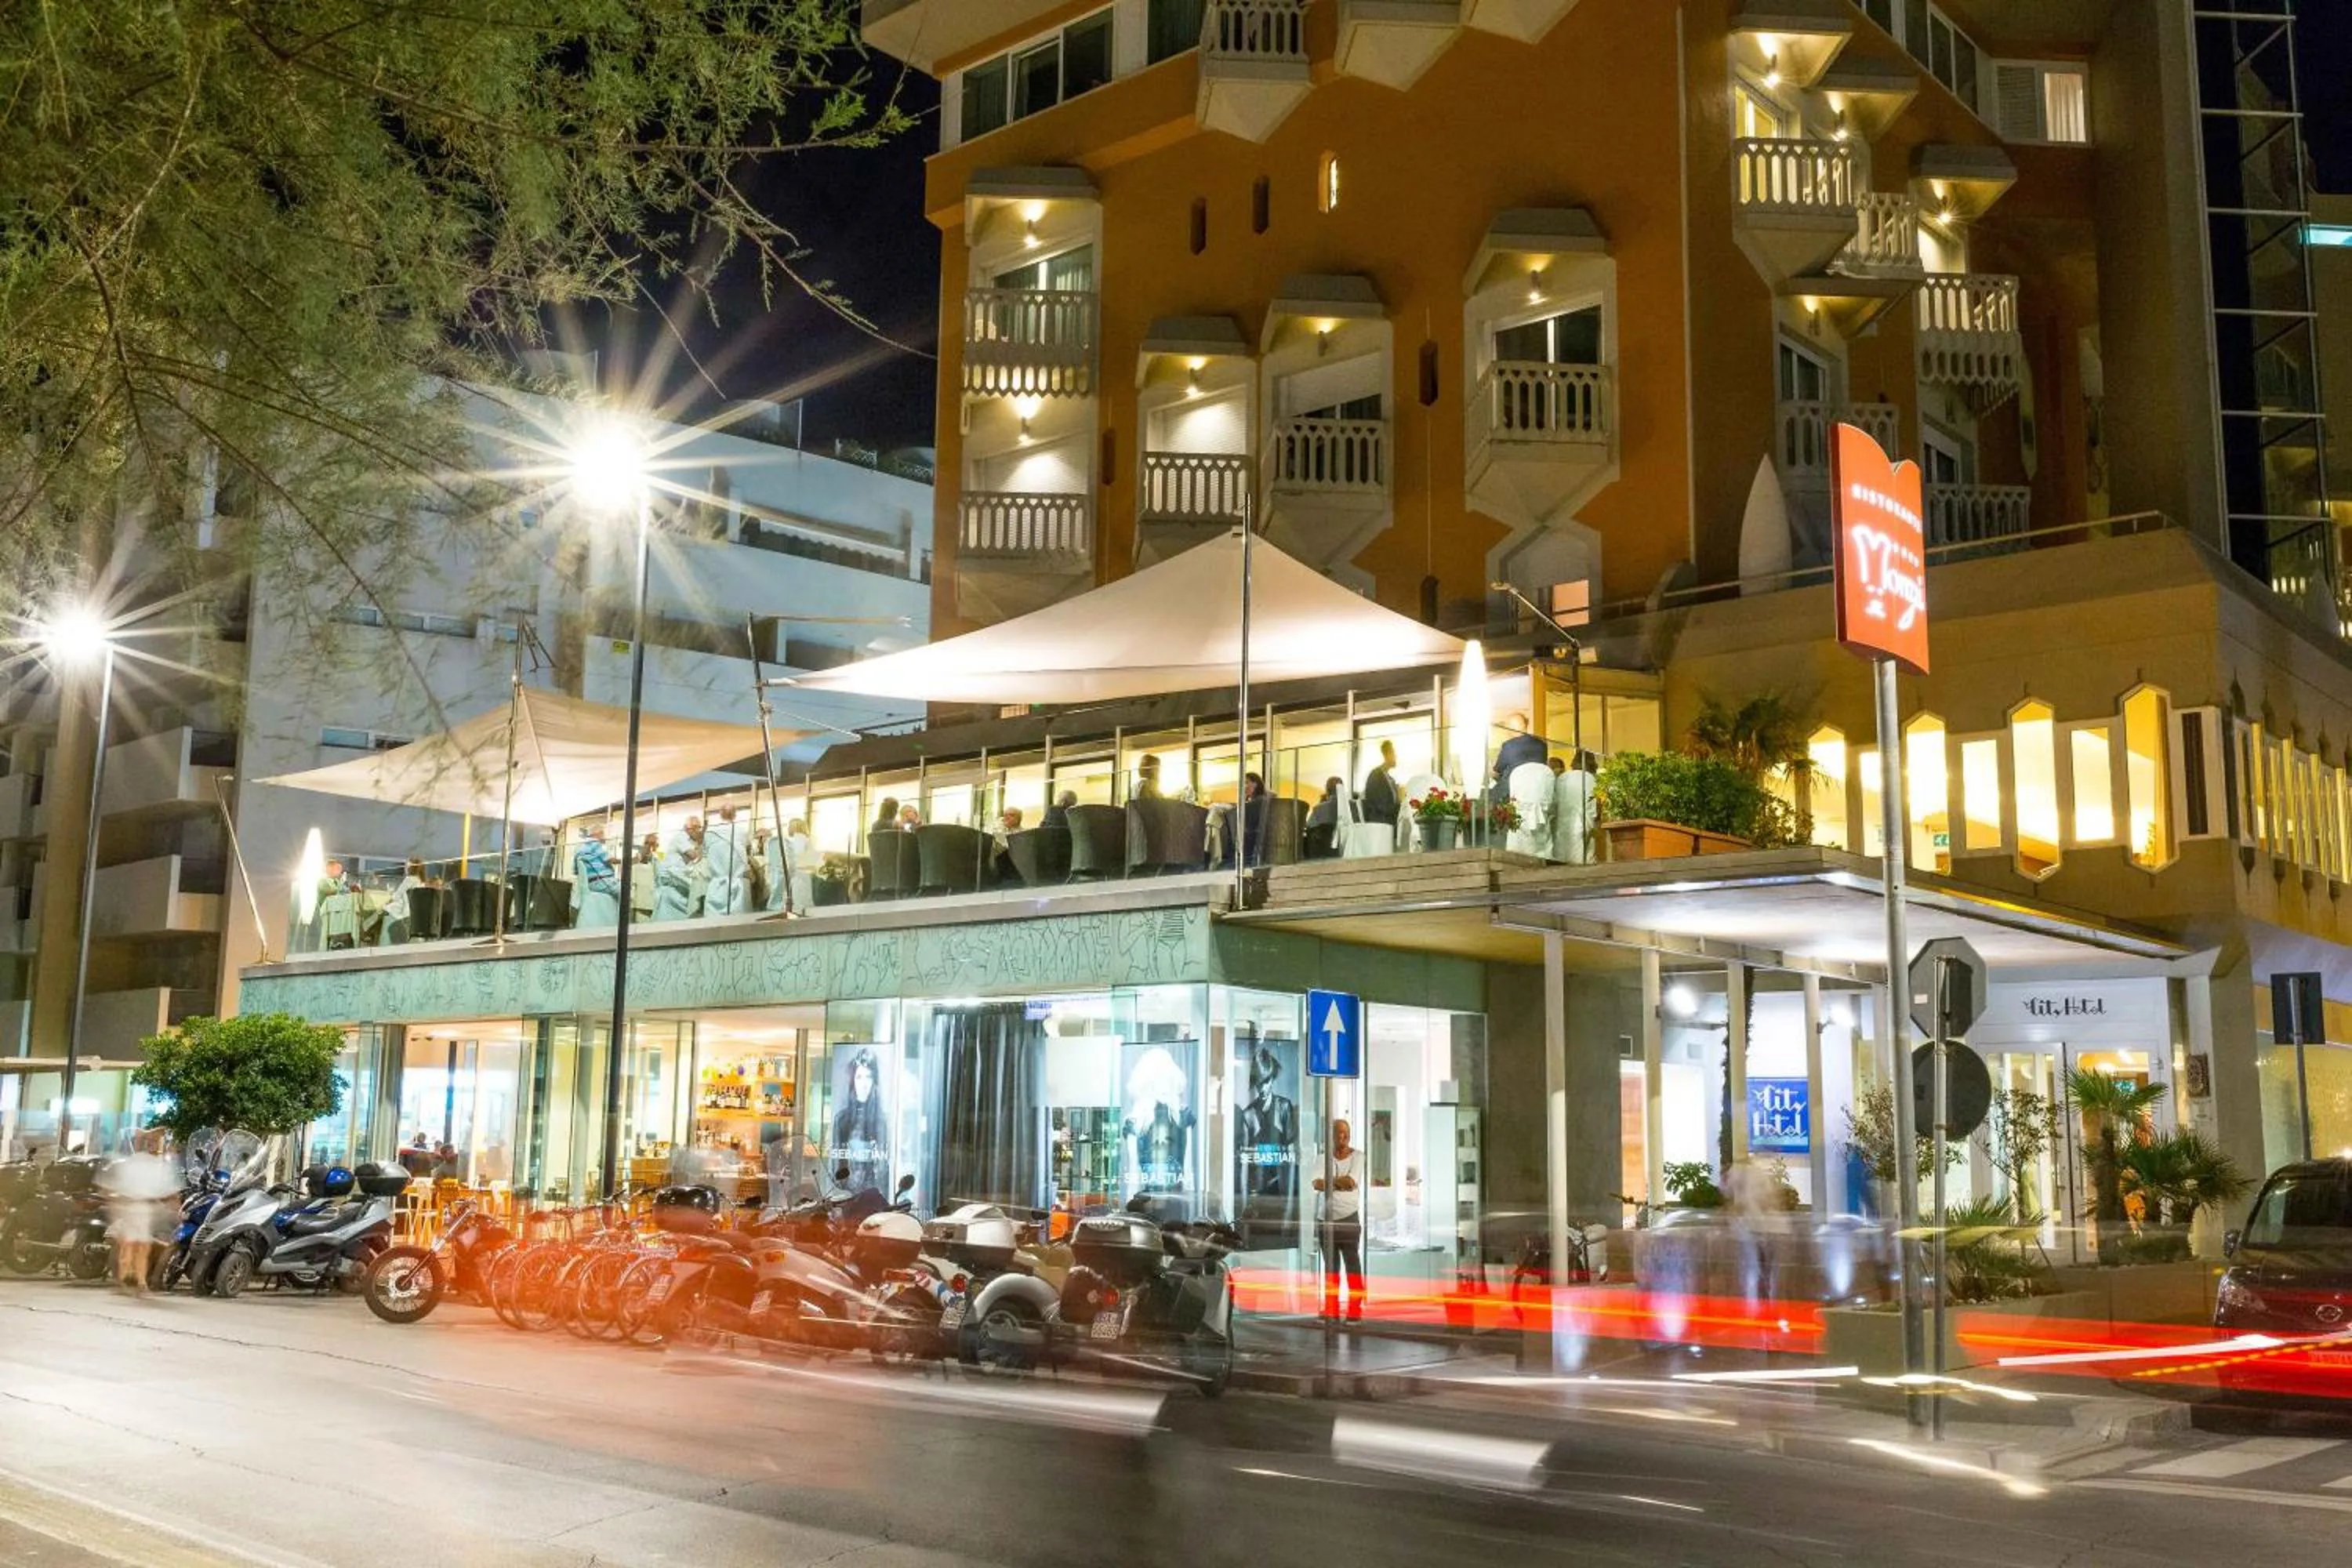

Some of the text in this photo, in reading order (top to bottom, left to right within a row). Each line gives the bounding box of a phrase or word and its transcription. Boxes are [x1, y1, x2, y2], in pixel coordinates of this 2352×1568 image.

[2063, 996, 2107, 1015] Hotel
[1751, 1084, 1806, 1114] City
[1752, 1110, 1807, 1138] Hotel
[1240, 1151, 1297, 1164] SEBASTIAN
